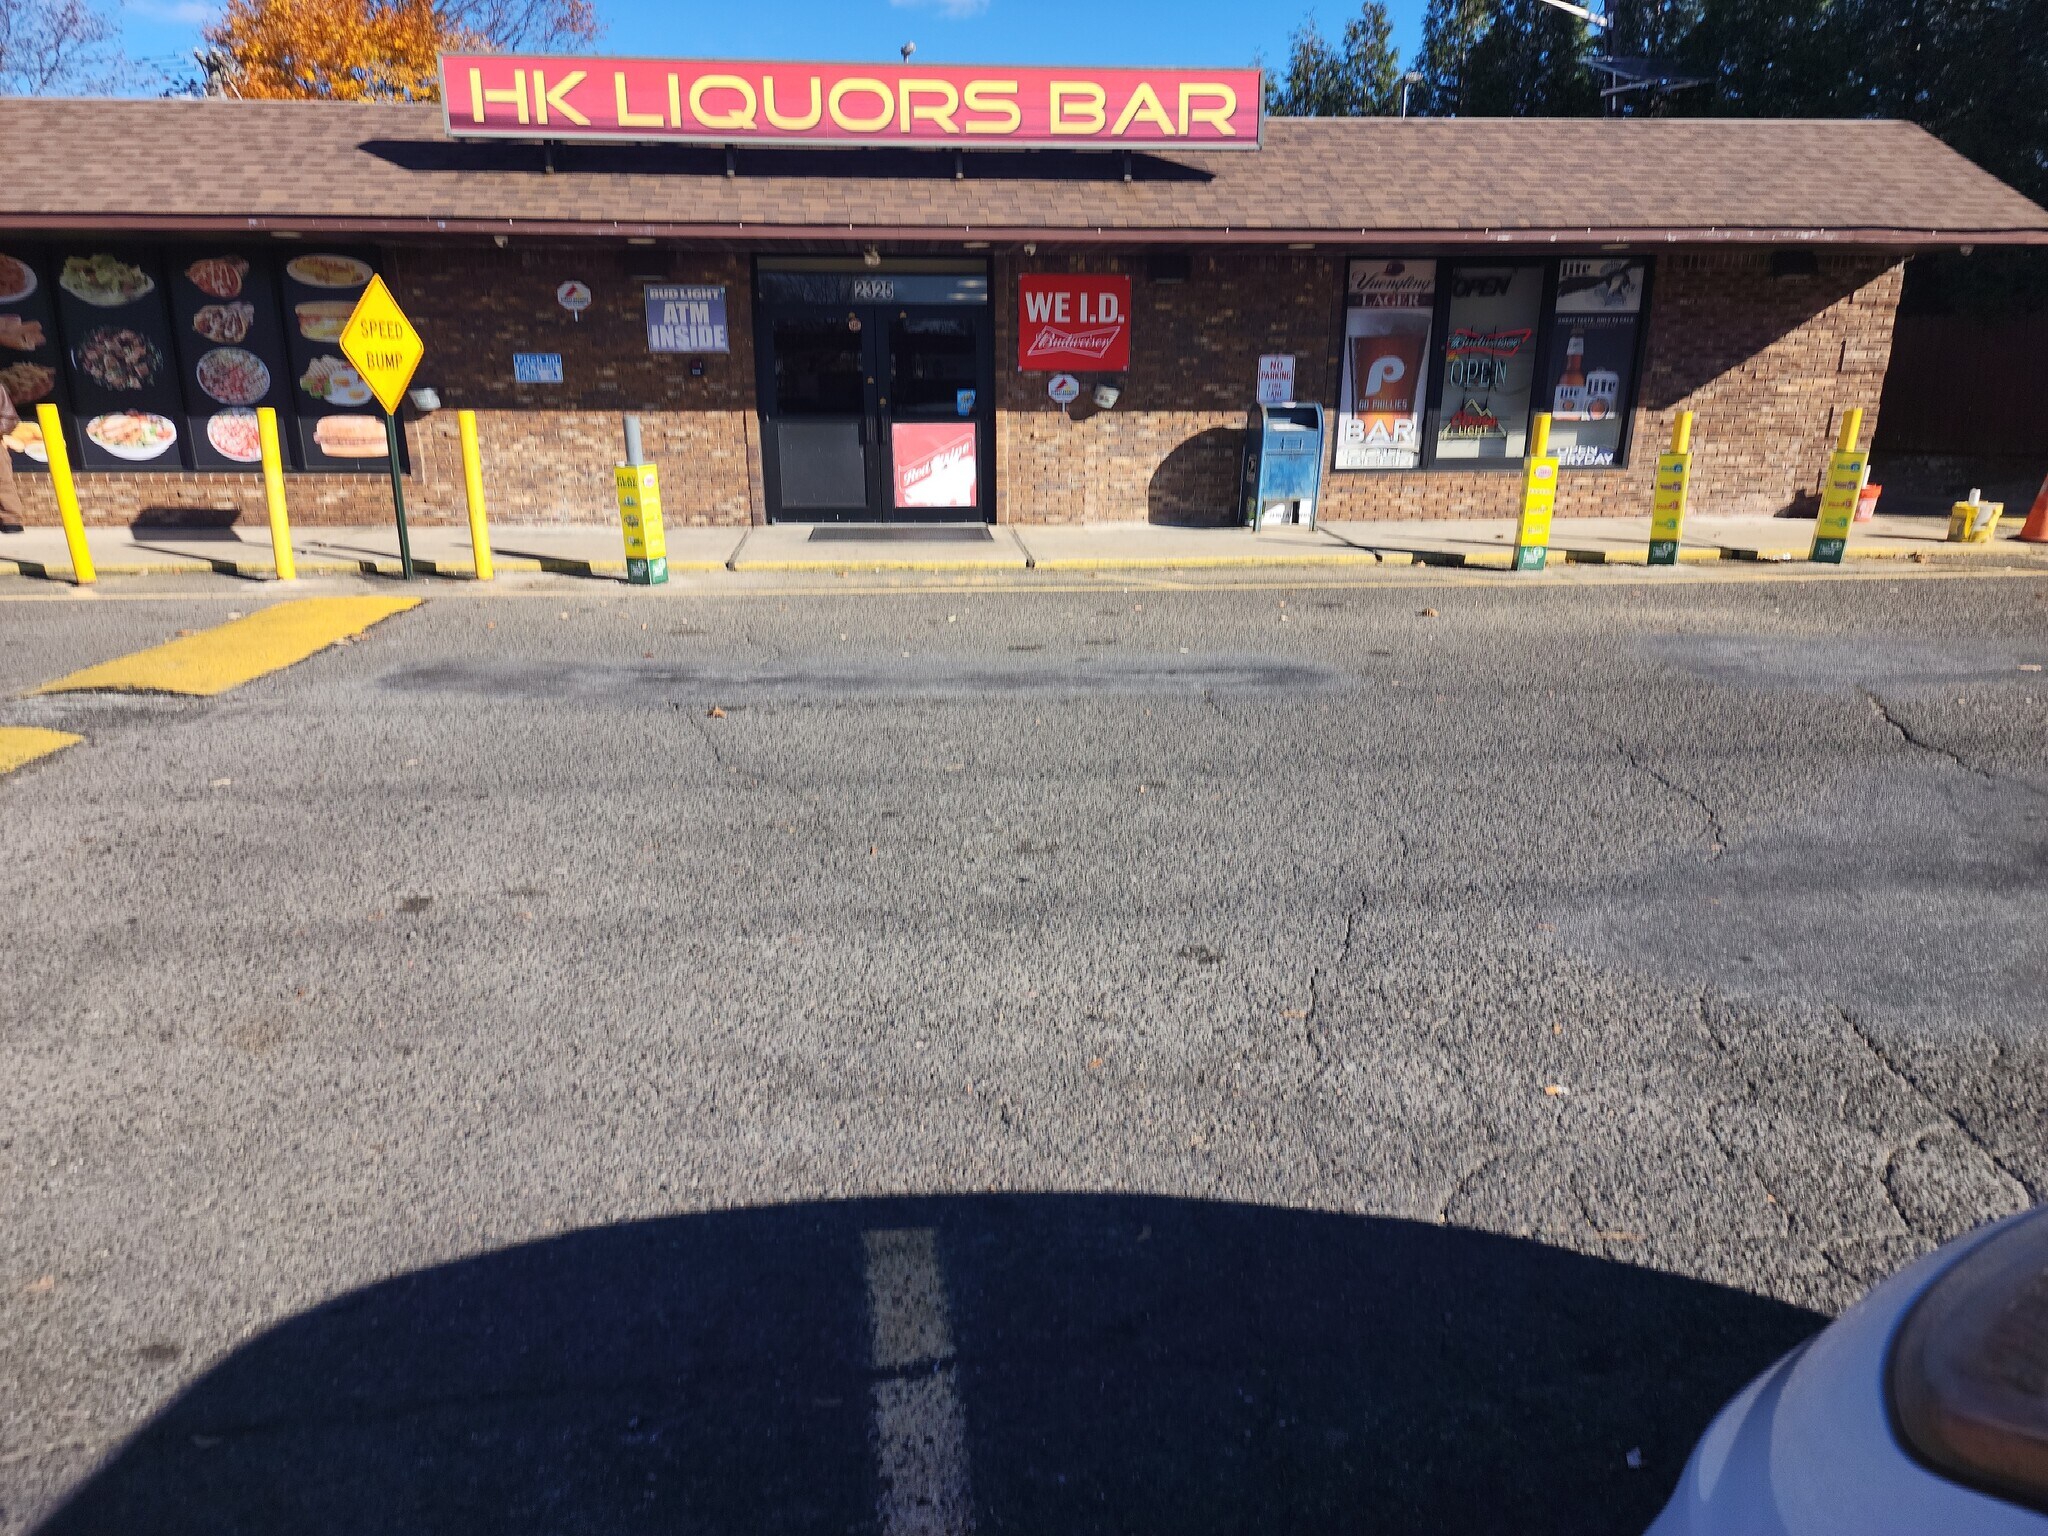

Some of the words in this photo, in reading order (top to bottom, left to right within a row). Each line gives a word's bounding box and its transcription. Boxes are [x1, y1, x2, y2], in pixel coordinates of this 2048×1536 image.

[469, 67, 591, 127] HK
[614, 72, 1021, 136] LIQUORS
[1049, 80, 1239, 138] BAR
[854, 280, 893, 298] 2325
[1351, 270, 1433, 293] Yuengling
[649, 287, 679, 300] BUD
[680, 287, 721, 301] LIGHT
[1361, 293, 1421, 307] LAGER
[663, 301, 710, 326] ATM
[1025, 291, 1071, 323] WE
[1080, 291, 1125, 324] I.D.
[360, 319, 403, 340] SPEED
[651, 324, 727, 351] INSIDE
[1035, 332, 1111, 350] Budweiser
[366, 350, 403, 371] BUMP
[1270, 361, 1284, 371] NO
[1261, 370, 1291, 381] PARKING
[1450, 358, 1507, 388] OPEN
[1359, 399, 1369, 410] GO
[1373, 399, 1408, 411] PHILLIES
[1345, 418, 1414, 445] BAR
[1458, 424, 1489, 437] LIGHT
